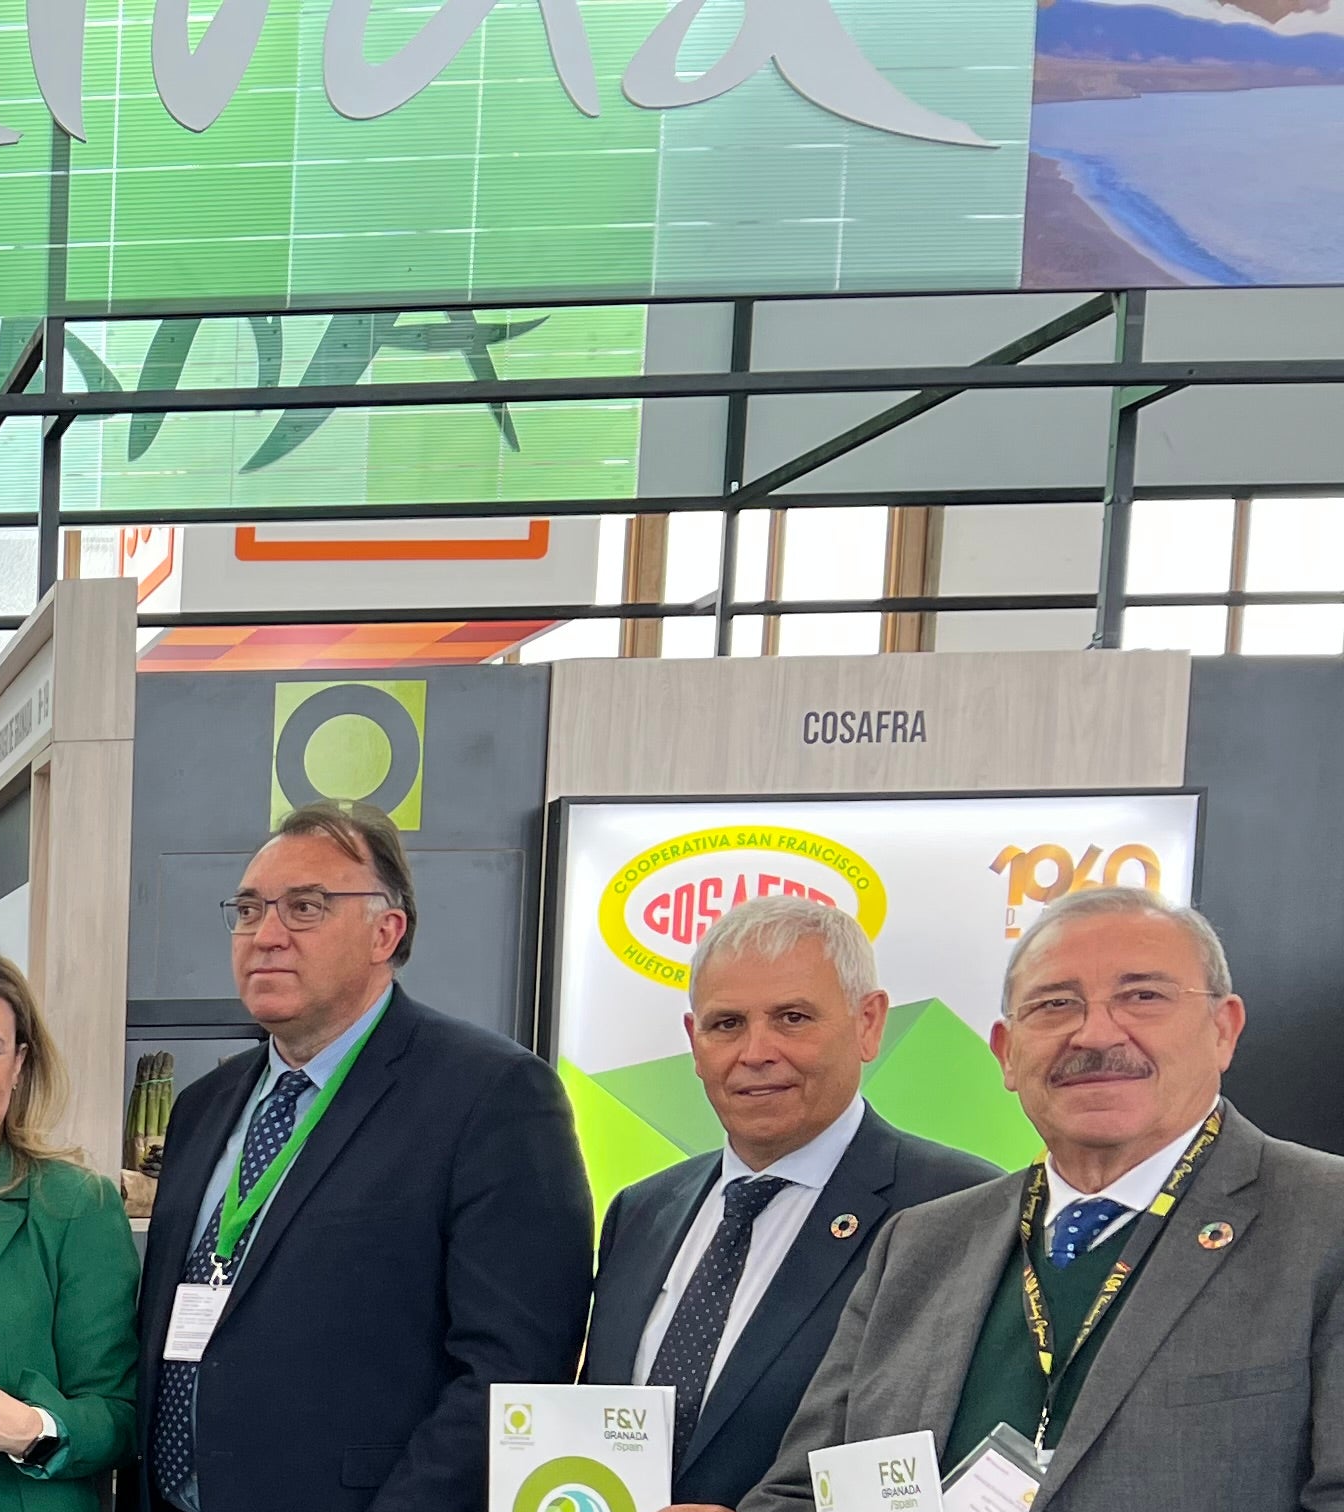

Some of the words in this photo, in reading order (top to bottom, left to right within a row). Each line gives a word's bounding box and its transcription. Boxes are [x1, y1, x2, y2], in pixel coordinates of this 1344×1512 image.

[803, 709, 927, 744] COSAFRA
[614, 834, 730, 894] COOPERATIVA
[736, 832, 772, 847] SAN
[777, 834, 870, 890] FRANCISCO
[623, 945, 686, 983] HUÉTOR
[603, 1408, 646, 1429] F&V
[604, 1430, 648, 1441] GRANADA
[878, 1457, 917, 1486] F&V
[881, 1485, 921, 1499] GRANADA
